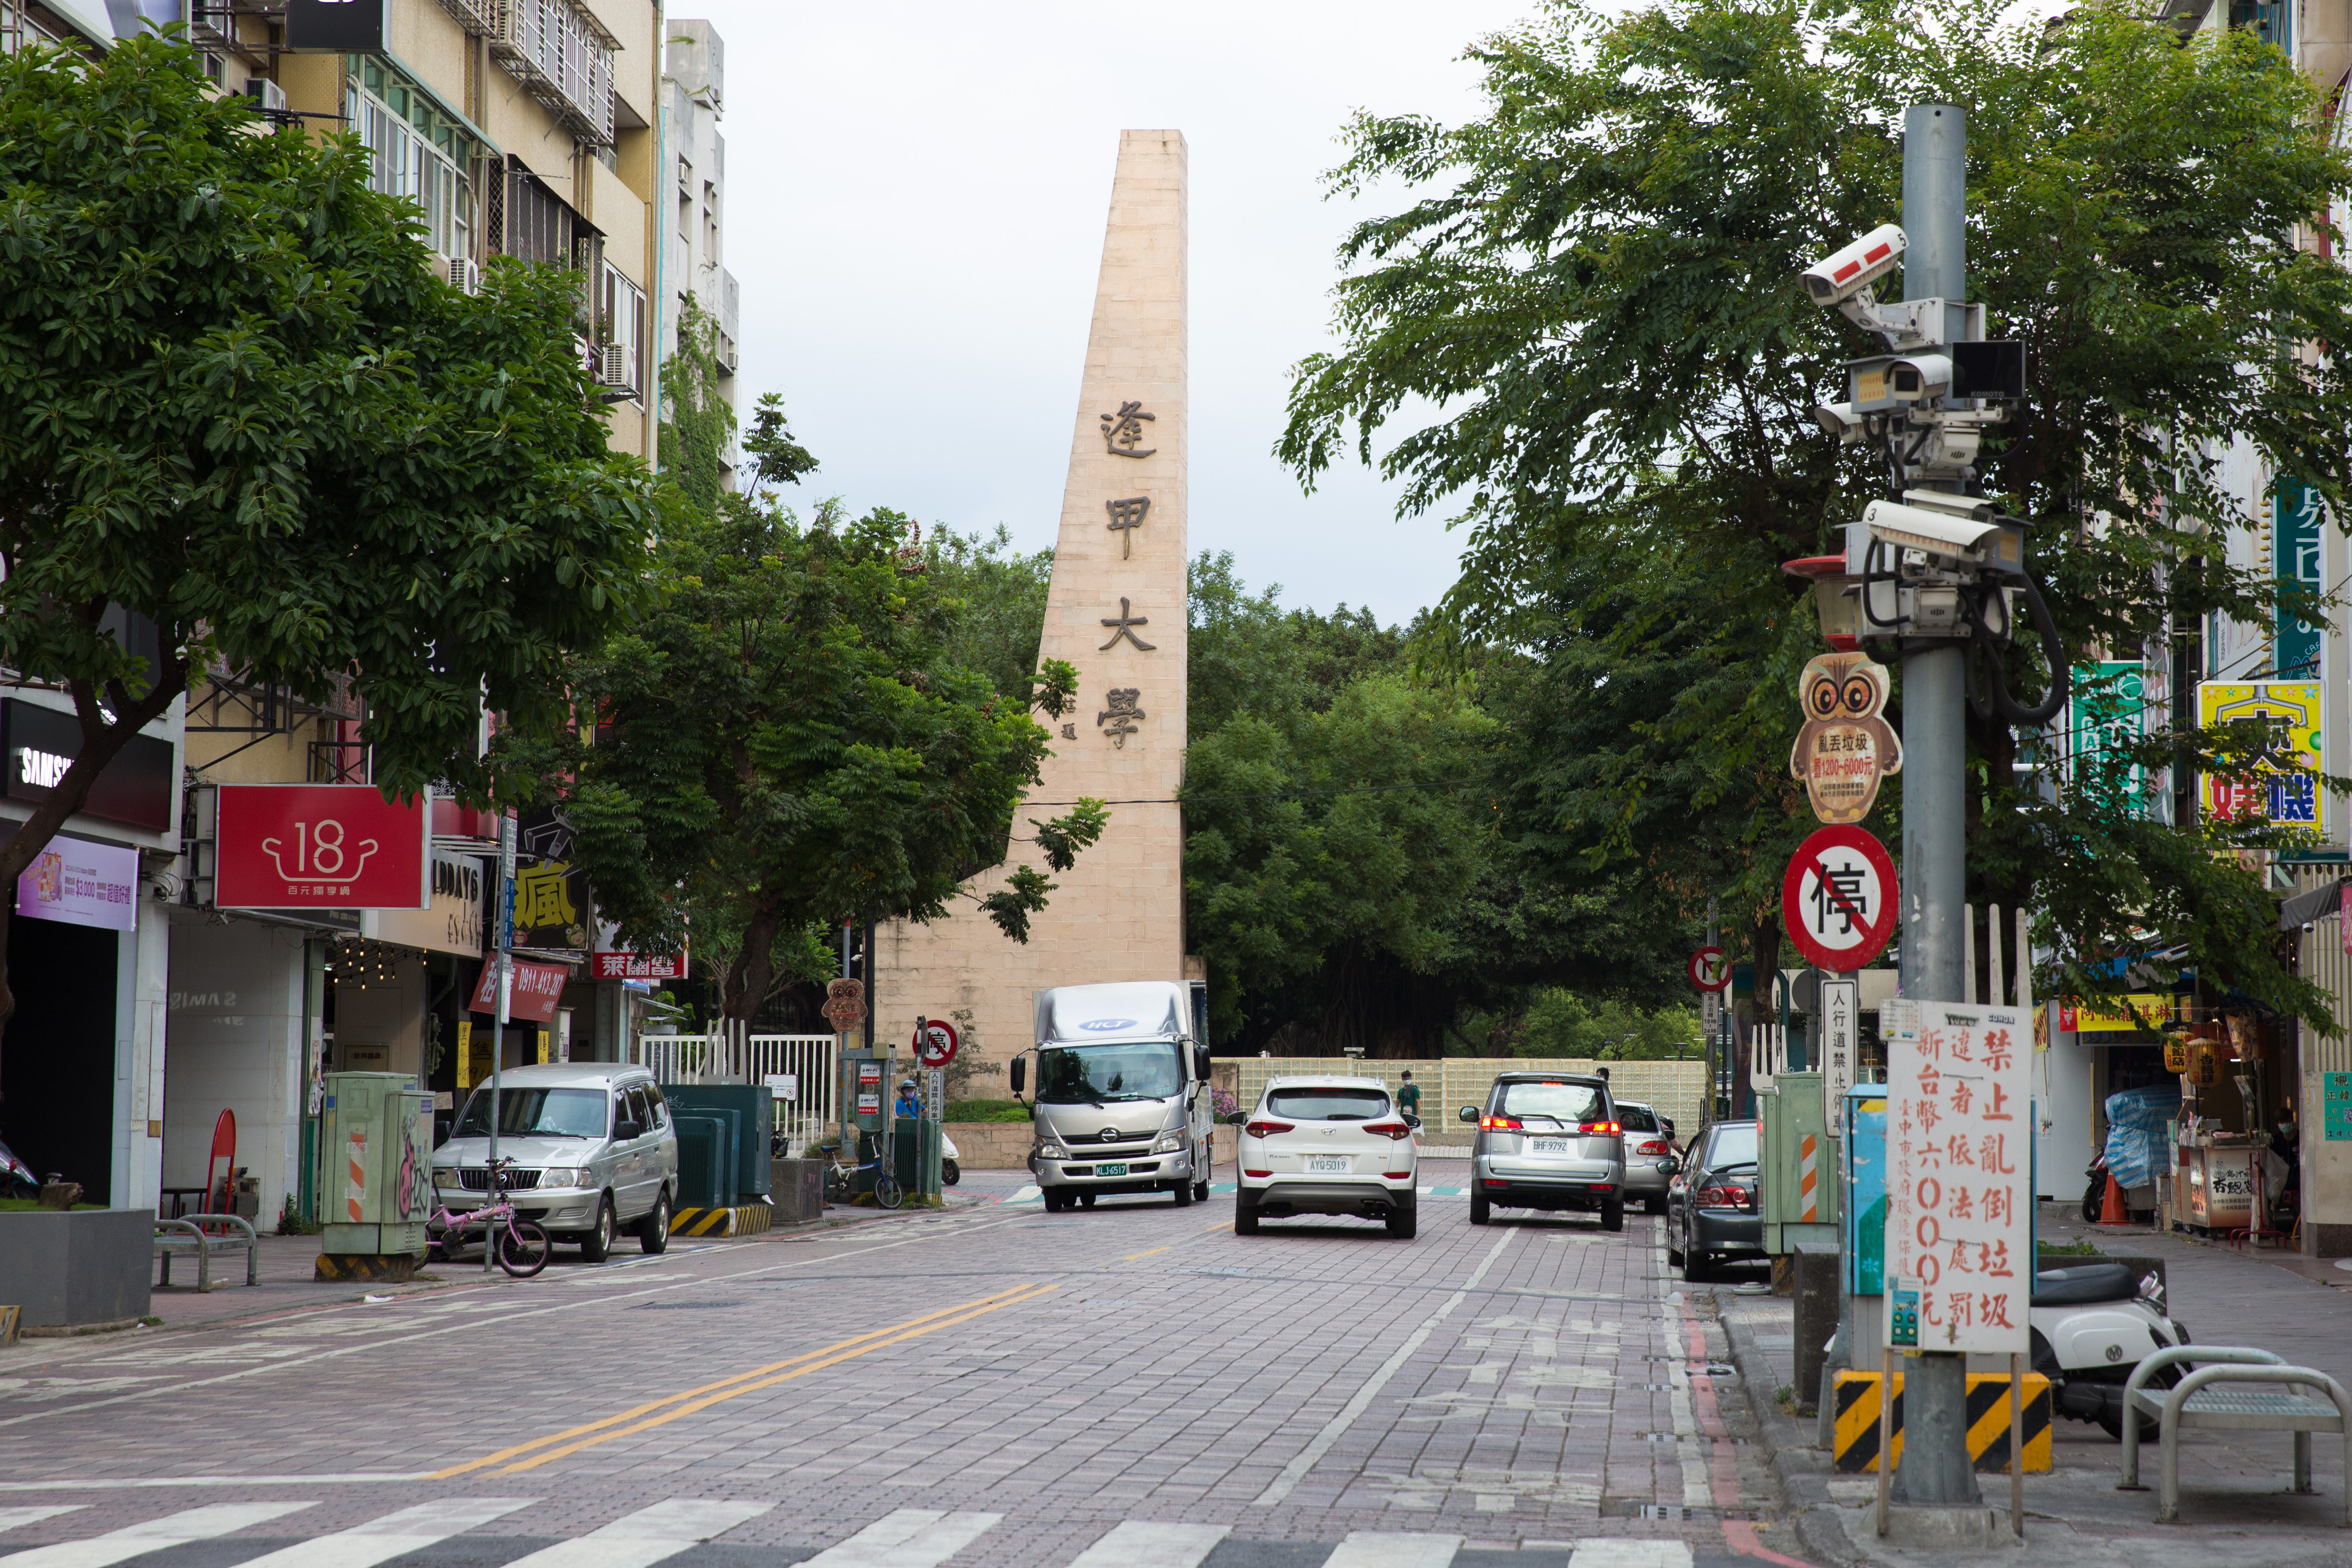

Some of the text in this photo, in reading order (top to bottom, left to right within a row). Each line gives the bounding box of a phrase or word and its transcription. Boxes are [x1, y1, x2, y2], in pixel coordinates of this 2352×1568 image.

[1897, 233, 1907, 247] 5
[1868, 508, 1877, 521] 3
[1097, 400, 1156, 750] 逢甲大學
[2305, 641, 2320, 655] CAF
[1818, 733, 1867, 753] 亂丟垃圾
[22, 747, 75, 788] SAMS
[294, 819, 344, 873] 18
[76, 877, 95, 898] $3,000
[107, 882, 131, 904] 超值好禮
[288, 885, 351, 896] 百元獨享鍋
[512, 858, 577, 929] 瘋
[1810, 862, 1866, 935] 停
[1087, 1020, 1127, 1029] HCT
[927, 1031, 946, 1054] 停
[1534, 1141, 1567, 1151] BHF-9792
[1096, 1165, 1126, 1175] KLJ-6517
[1310, 1160, 1346, 1170] AYQ-5019
[1947, 1031, 1975, 1328] 違者依法處罰
[1978, 1028, 2015, 1330] 禁止亂倒垃圾
